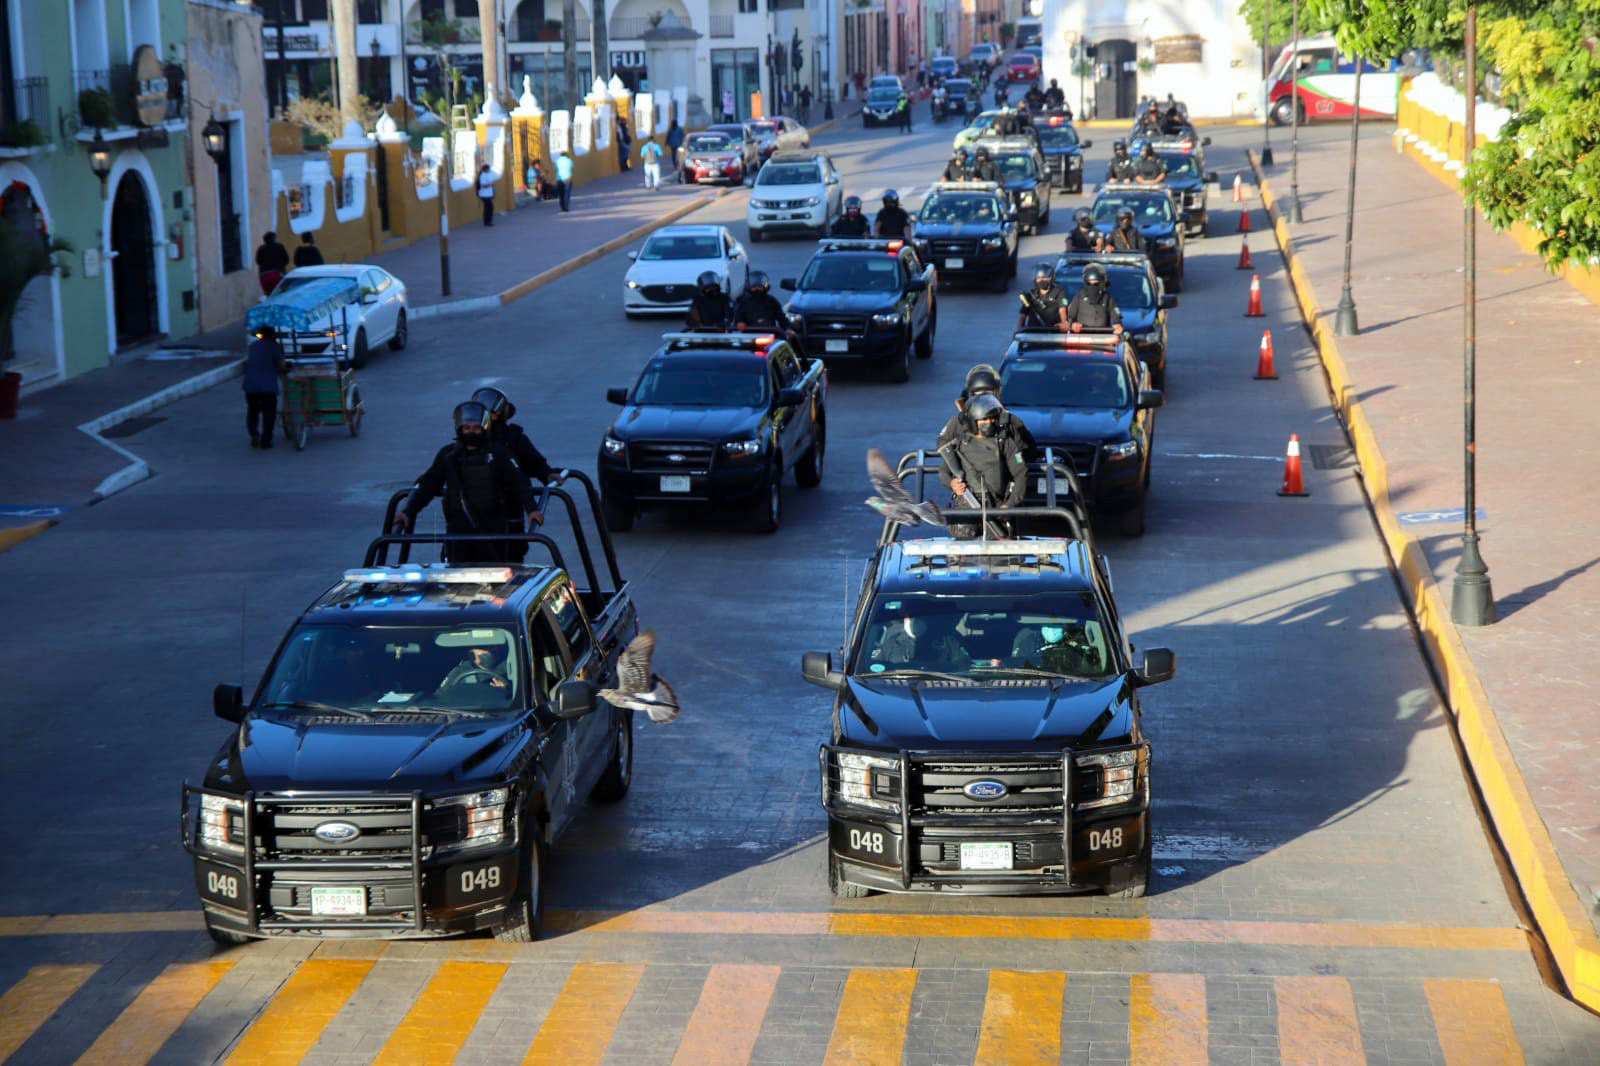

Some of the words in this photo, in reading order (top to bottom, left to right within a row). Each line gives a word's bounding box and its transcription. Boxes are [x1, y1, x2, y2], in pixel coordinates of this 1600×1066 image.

[974, 785, 997, 796] Ford
[850, 829, 883, 854] 048
[1089, 827, 1122, 851] 048
[208, 871, 237, 899] 049
[461, 865, 500, 892] 049
